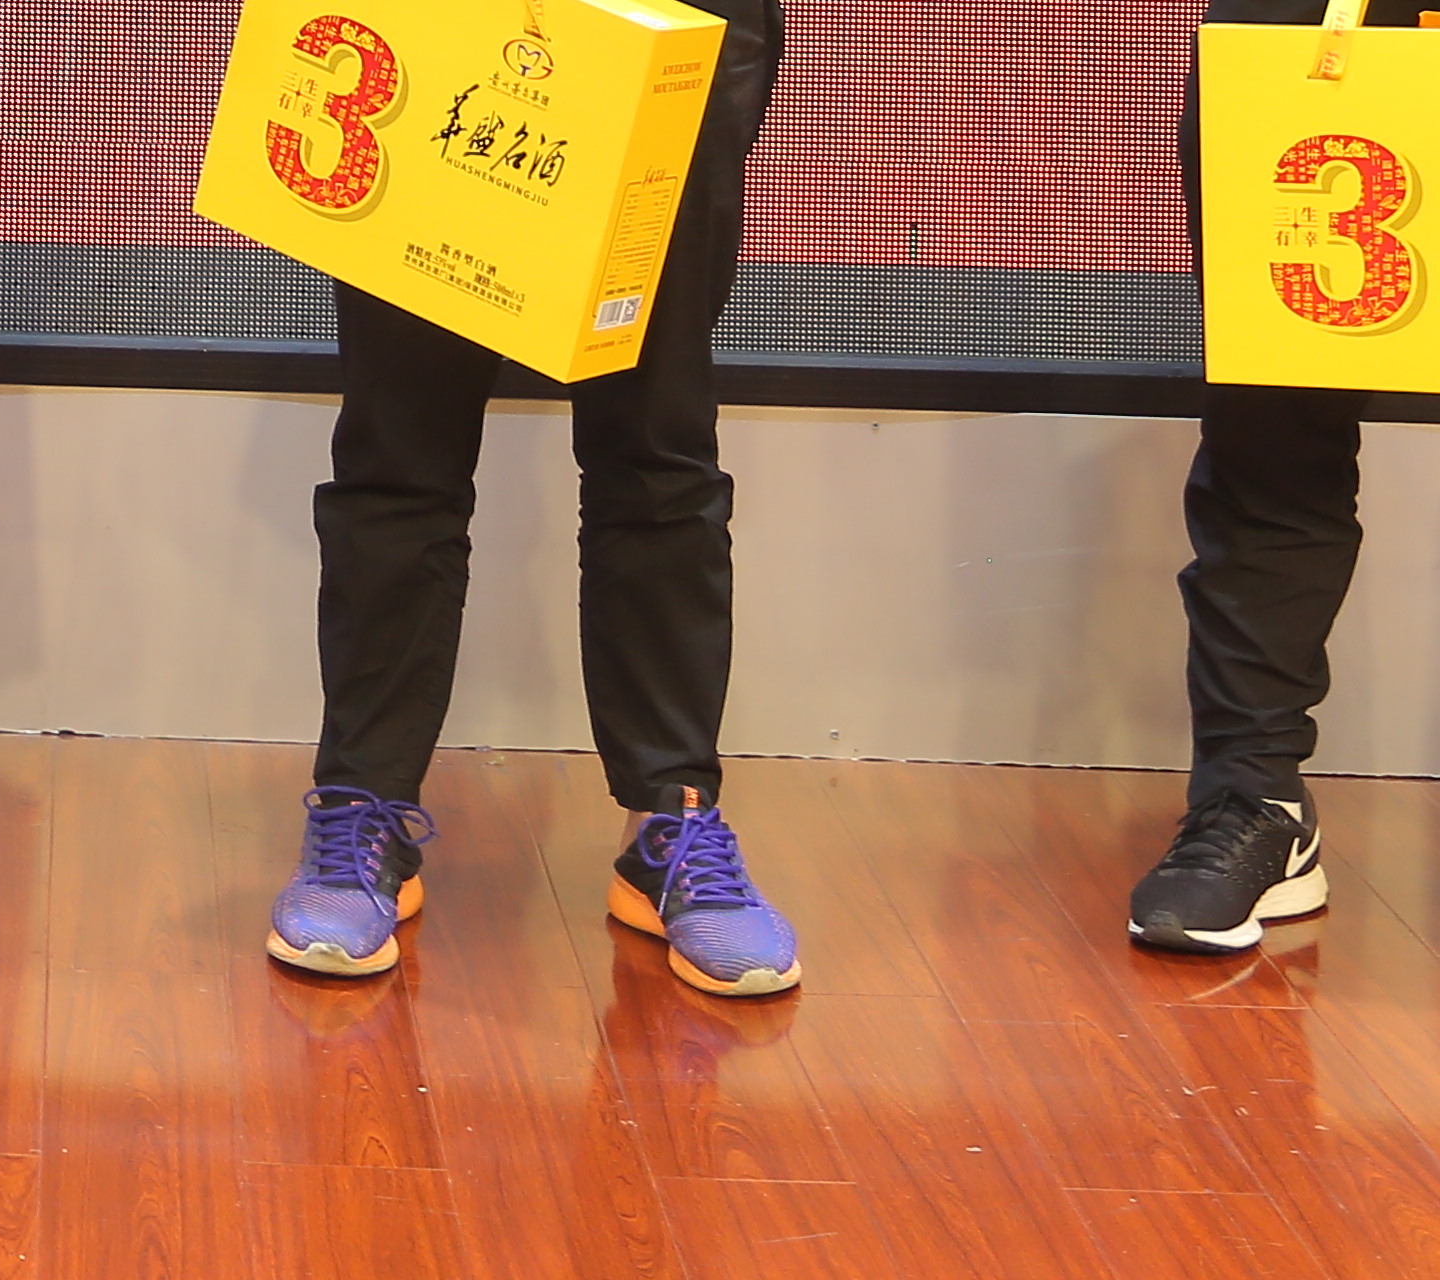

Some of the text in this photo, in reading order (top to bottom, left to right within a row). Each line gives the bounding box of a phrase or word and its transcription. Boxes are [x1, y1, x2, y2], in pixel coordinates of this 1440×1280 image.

[264, 14, 401, 211] 3
[446, 156, 549, 207] HUASHENGMINGJIU
[1269, 133, 1416, 329] 3
